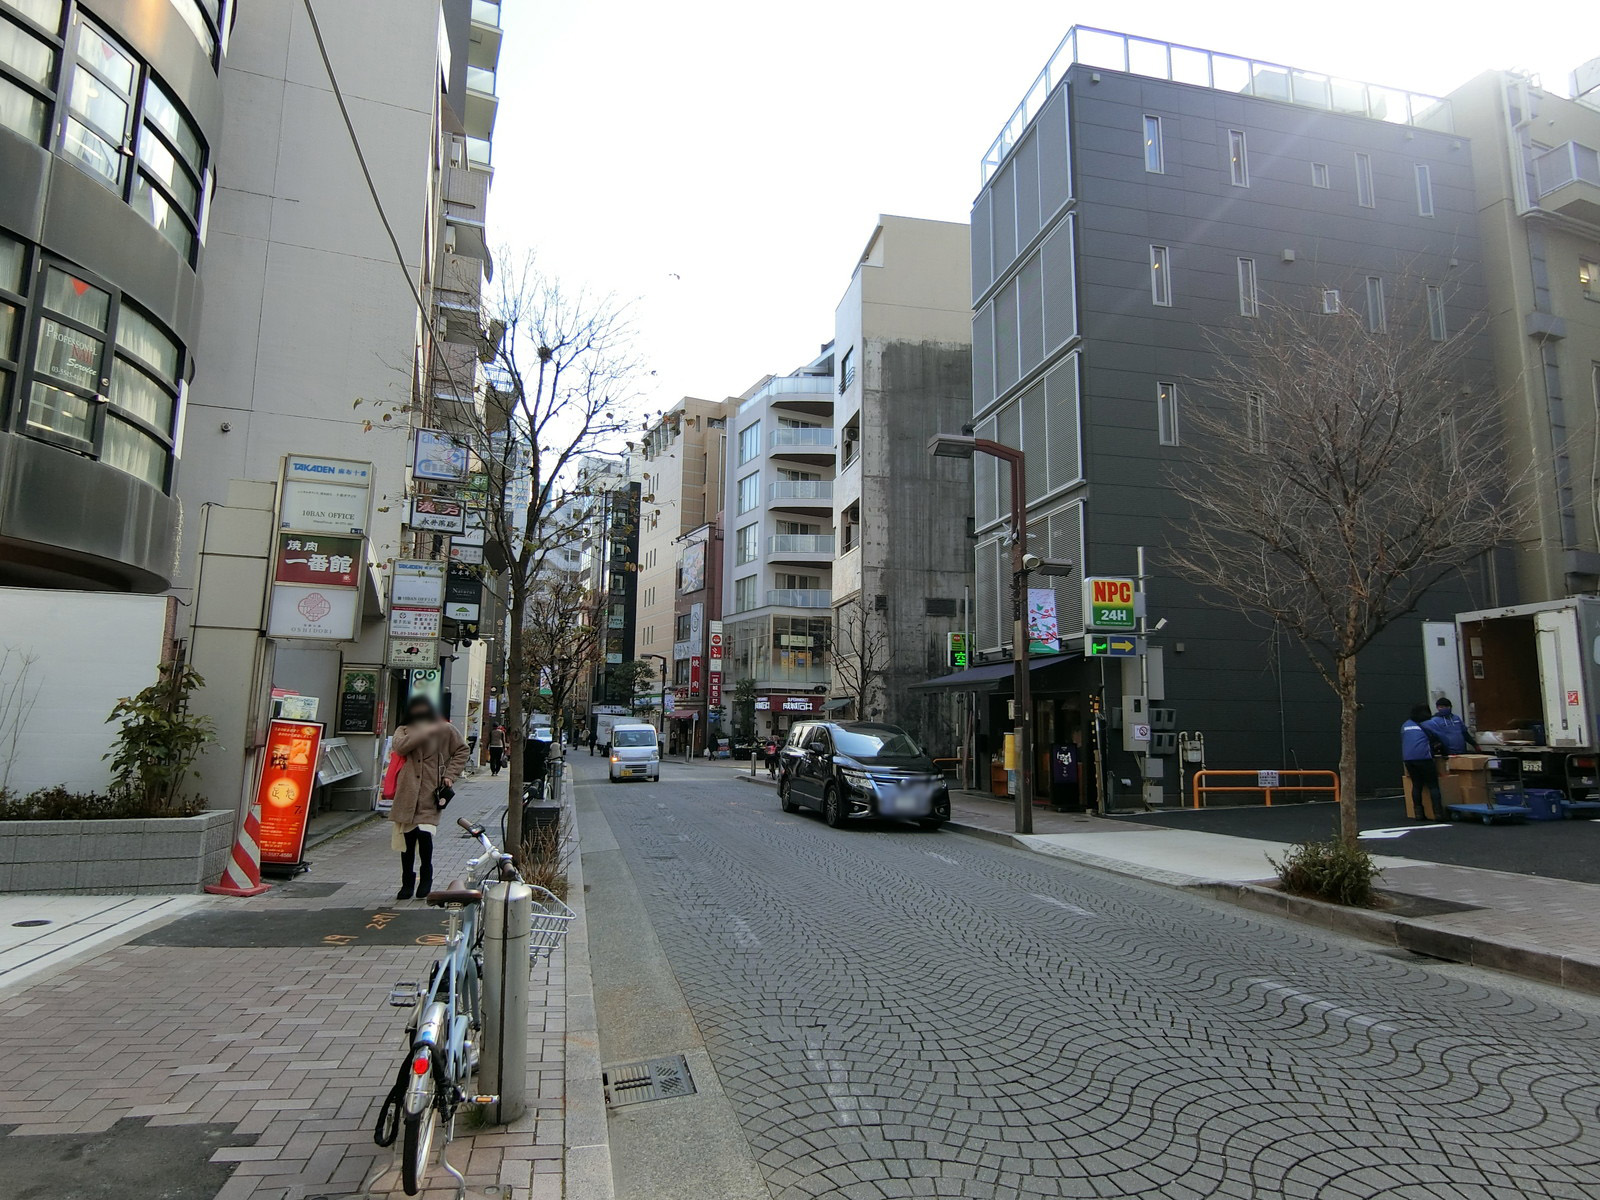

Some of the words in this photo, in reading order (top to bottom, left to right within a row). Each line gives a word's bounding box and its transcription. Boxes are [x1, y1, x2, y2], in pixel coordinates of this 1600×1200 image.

[66, 357, 97, 376] Service
[293, 463, 335, 474] TAKADEN
[338, 468, 367, 477] 麻布十番
[418, 501, 460, 514] 漢方
[328, 512, 355, 520] OFFICE
[287, 540, 318, 552] 焼肉
[285, 554, 353, 573] 一番館
[1094, 581, 1131, 603] NPC
[1101, 610, 1127, 620] 24H
[954, 652, 967, 665] 空
[782, 702, 813, 710] 成城石井
